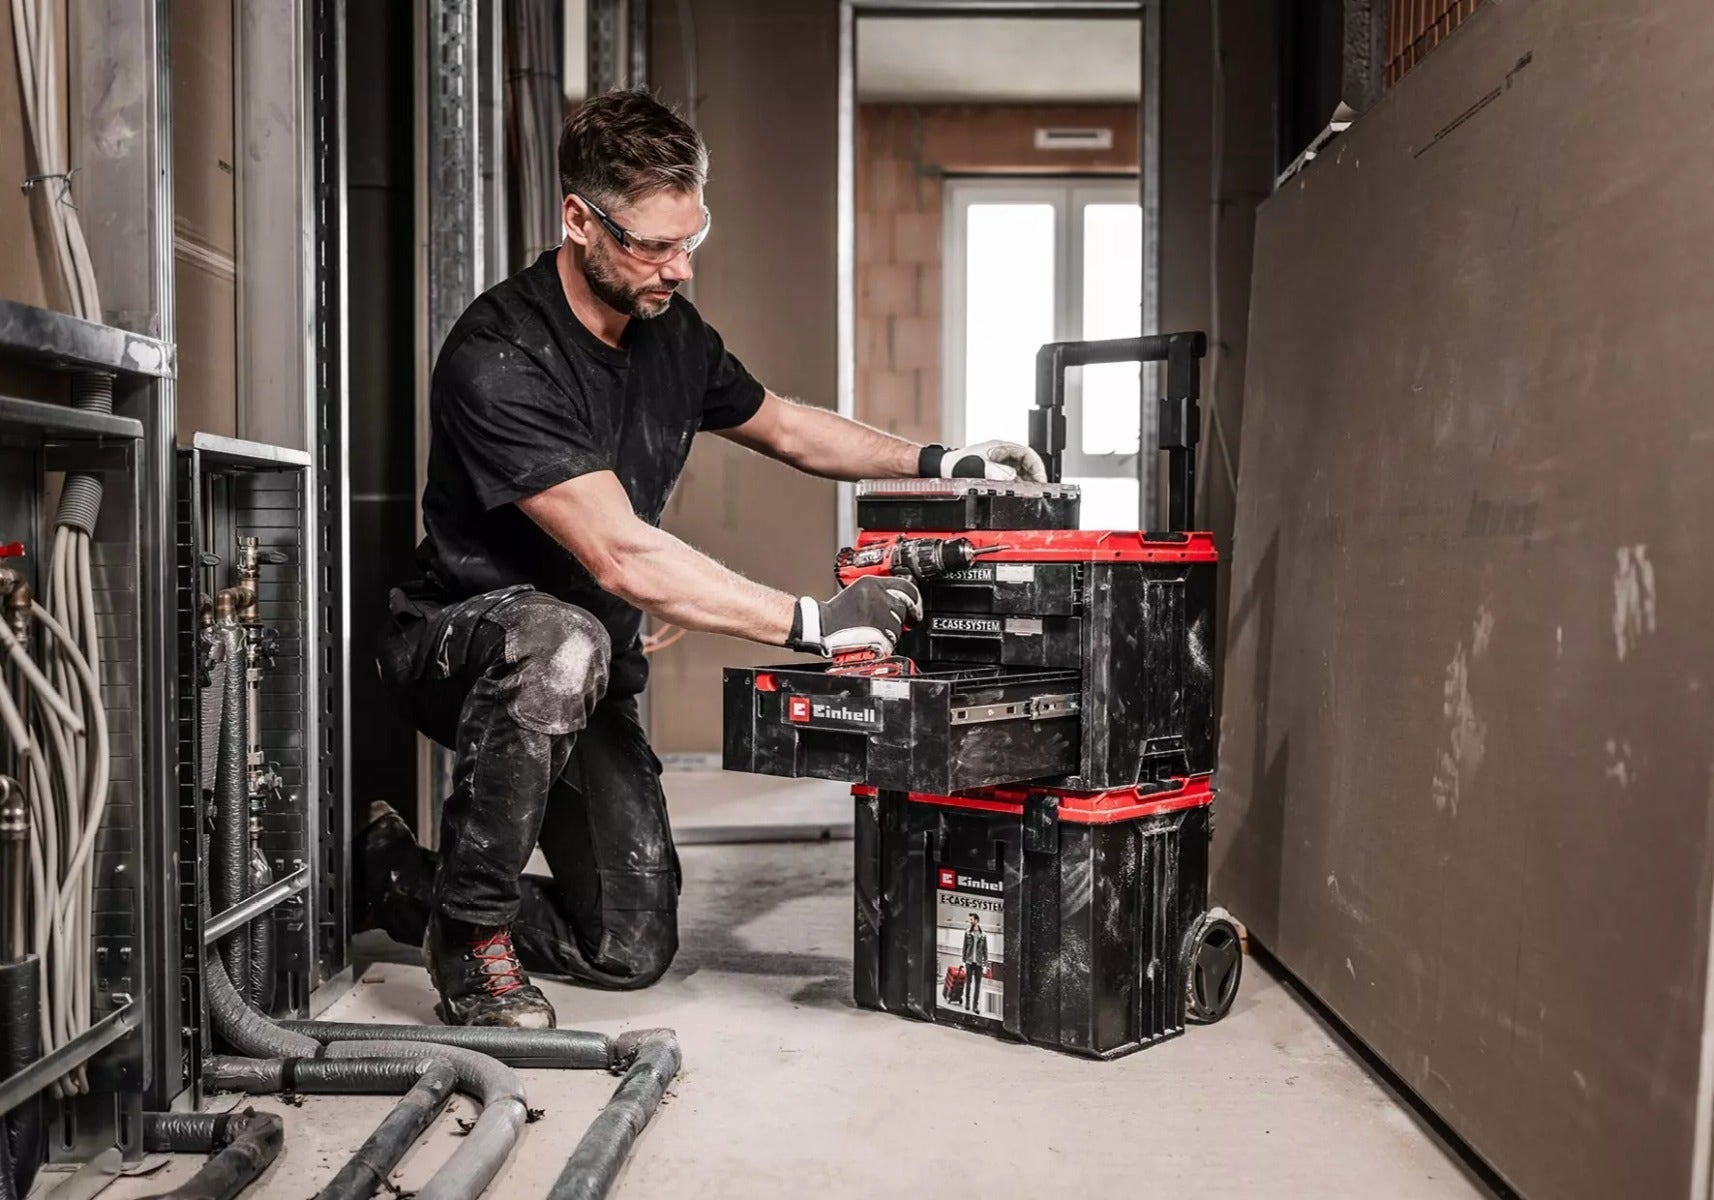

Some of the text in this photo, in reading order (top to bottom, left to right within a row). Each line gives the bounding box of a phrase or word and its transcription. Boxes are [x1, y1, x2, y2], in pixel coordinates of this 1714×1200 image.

[933, 619, 1000, 631] E-CASE-SYSTEM
[812, 704, 875, 722] Einhell
[957, 875, 1003, 892] Einhel
